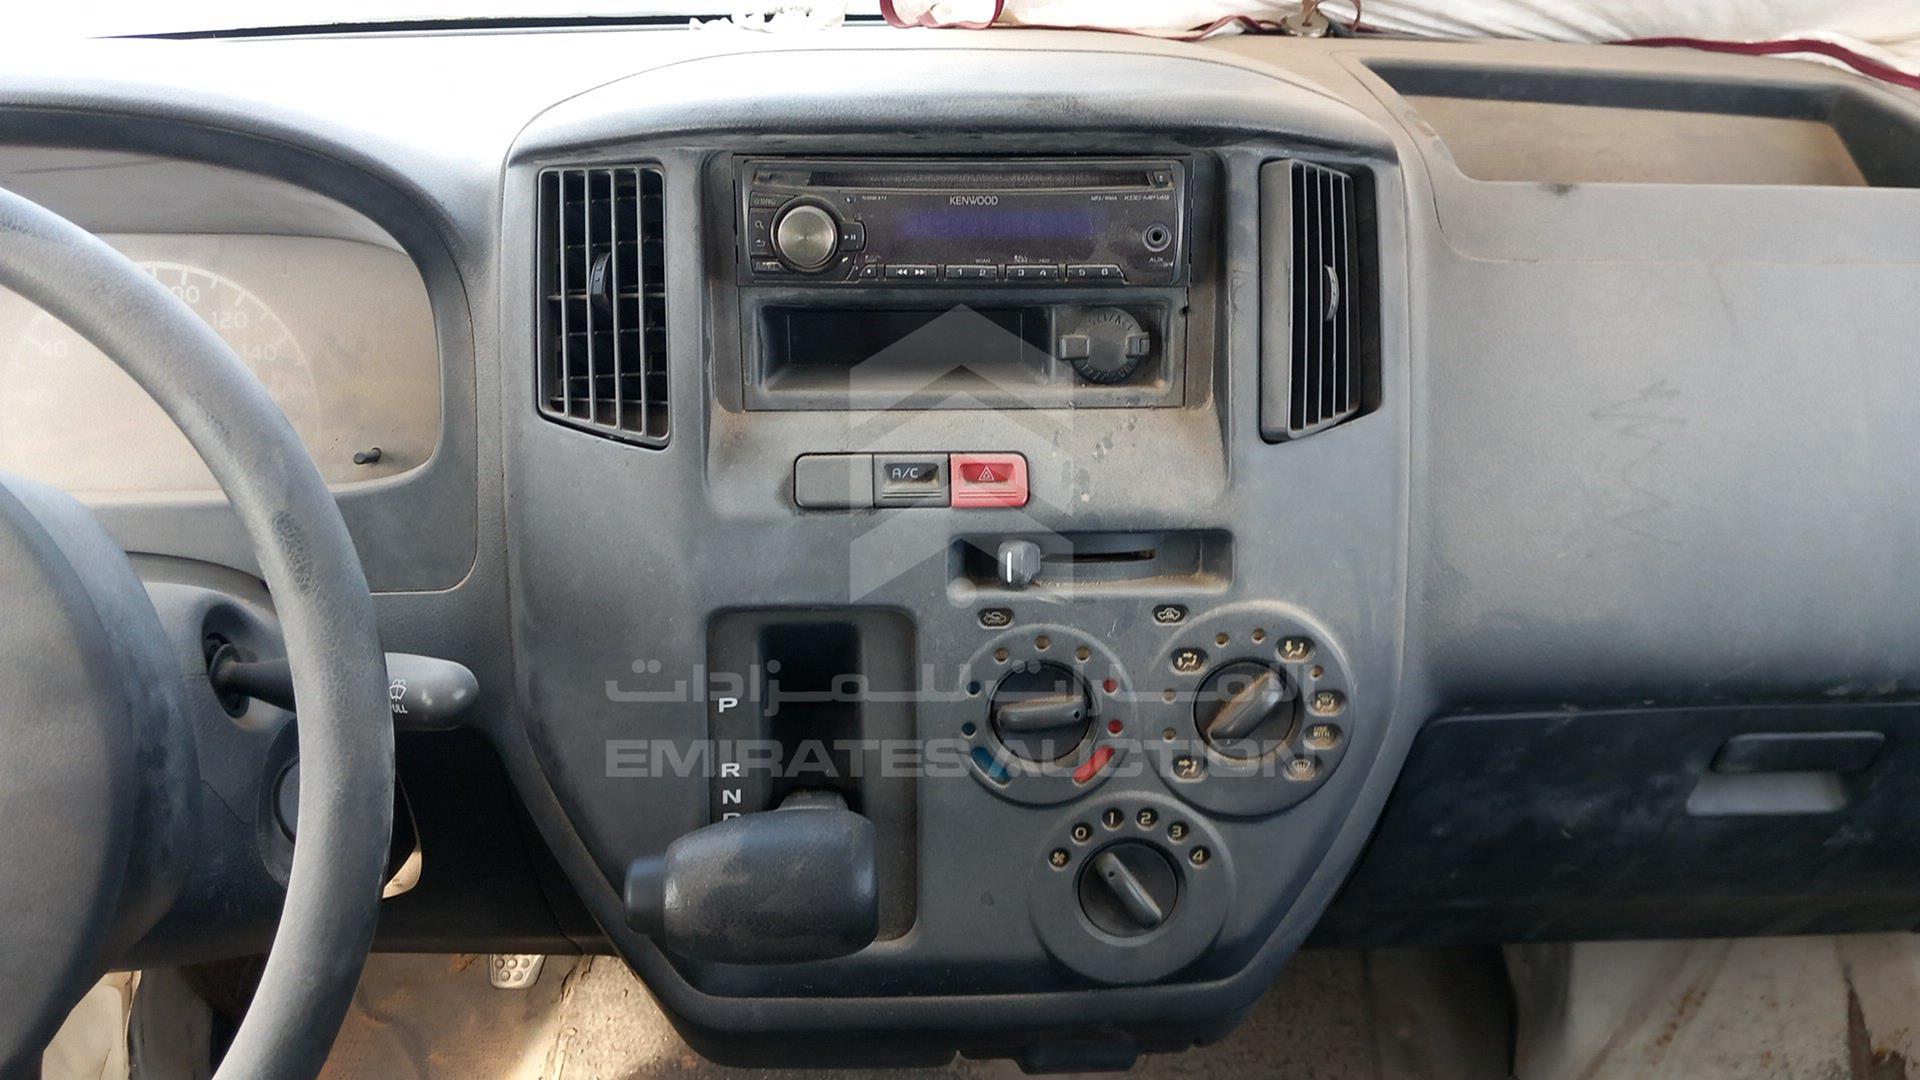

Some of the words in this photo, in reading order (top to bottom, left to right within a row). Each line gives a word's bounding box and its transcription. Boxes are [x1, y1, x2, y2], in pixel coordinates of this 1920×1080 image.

[949, 195, 999, 206] KENWOOD
[979, 268, 987, 277] 2
[1017, 268, 1025, 277] 3
[1039, 269, 1047, 277] 4
[211, 310, 248, 329] 120
[892, 467, 919, 479] A/C
[718, 697, 738, 713] P
[721, 763, 741, 778] R
[722, 788, 742, 805] N
[1109, 812, 1115, 825] 1
[1140, 812, 1152, 825] 2
[1075, 827, 1087, 839] 0
[1171, 825, 1183, 838] 3
[1192, 850, 1204, 862] 4
